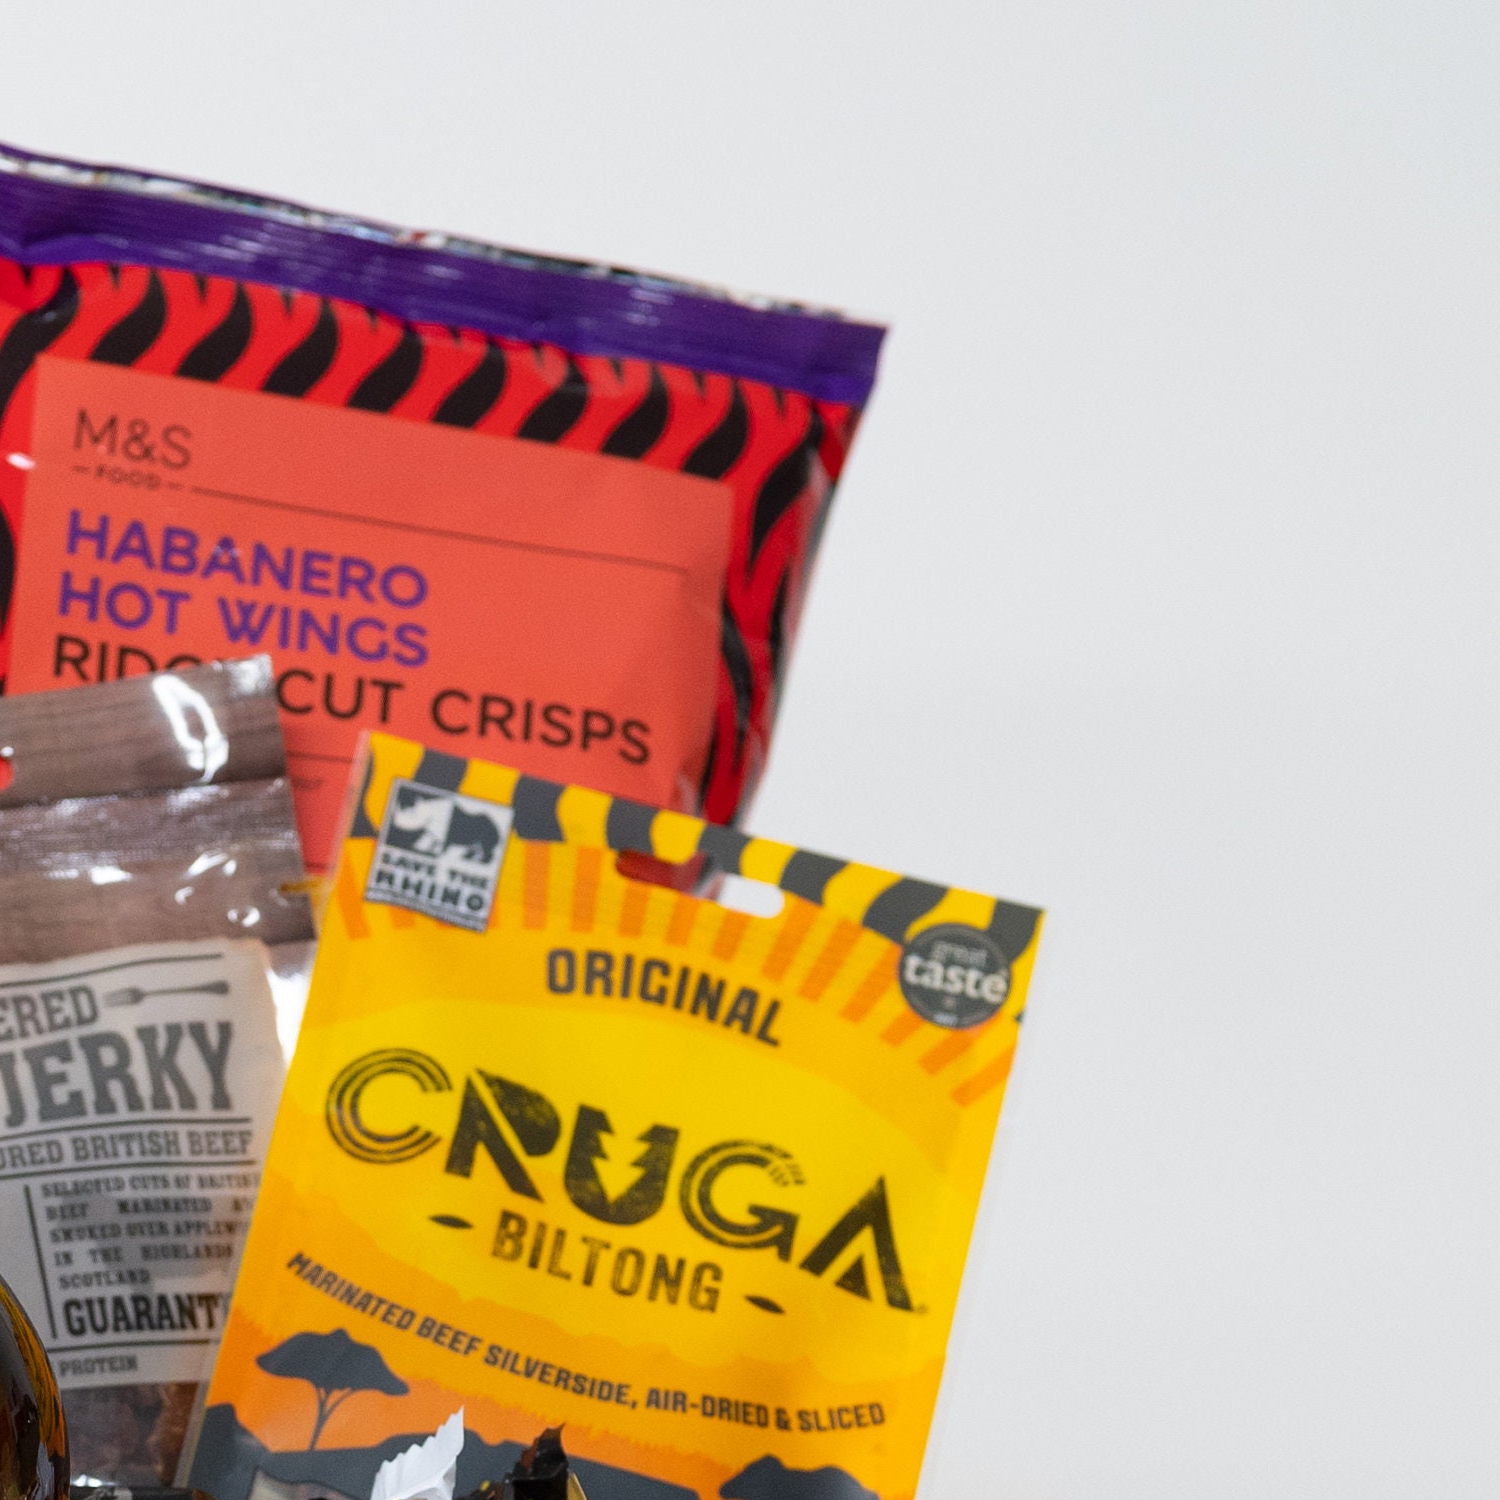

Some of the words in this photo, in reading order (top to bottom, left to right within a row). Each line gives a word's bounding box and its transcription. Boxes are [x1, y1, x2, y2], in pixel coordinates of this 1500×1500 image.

[71, 407, 193, 472] M&S
[65, 508, 429, 610] HABANERO
[58, 570, 191, 635] HOT
[217, 595, 429, 668] WINGS
[276, 669, 405, 725] CUT
[430, 688, 653, 767] CRISPS
[374, 869, 485, 912] RHINO
[381, 851, 437, 877] SAVE
[546, 946, 782, 1048] ORIGINAL
[904, 953, 1008, 1005] taste
[73, 1128, 180, 1163] BRITISH
[188, 1127, 252, 1158] BEEF
[325, 1047, 915, 1315] CRUGA
[491, 1209, 723, 1314] BILTONG
[62, 1292, 228, 1337] GUARANT
[286, 1251, 417, 1332] MARINATED
[416, 1315, 483, 1357] BEEF
[483, 1344, 638, 1410] SILVERSIDE,
[645, 1387, 769, 1428] AIR-DRIED
[774, 1406, 793, 1432] &
[797, 1402, 886, 1432] SLICED
[59, 1354, 139, 1377] PROTEIN
